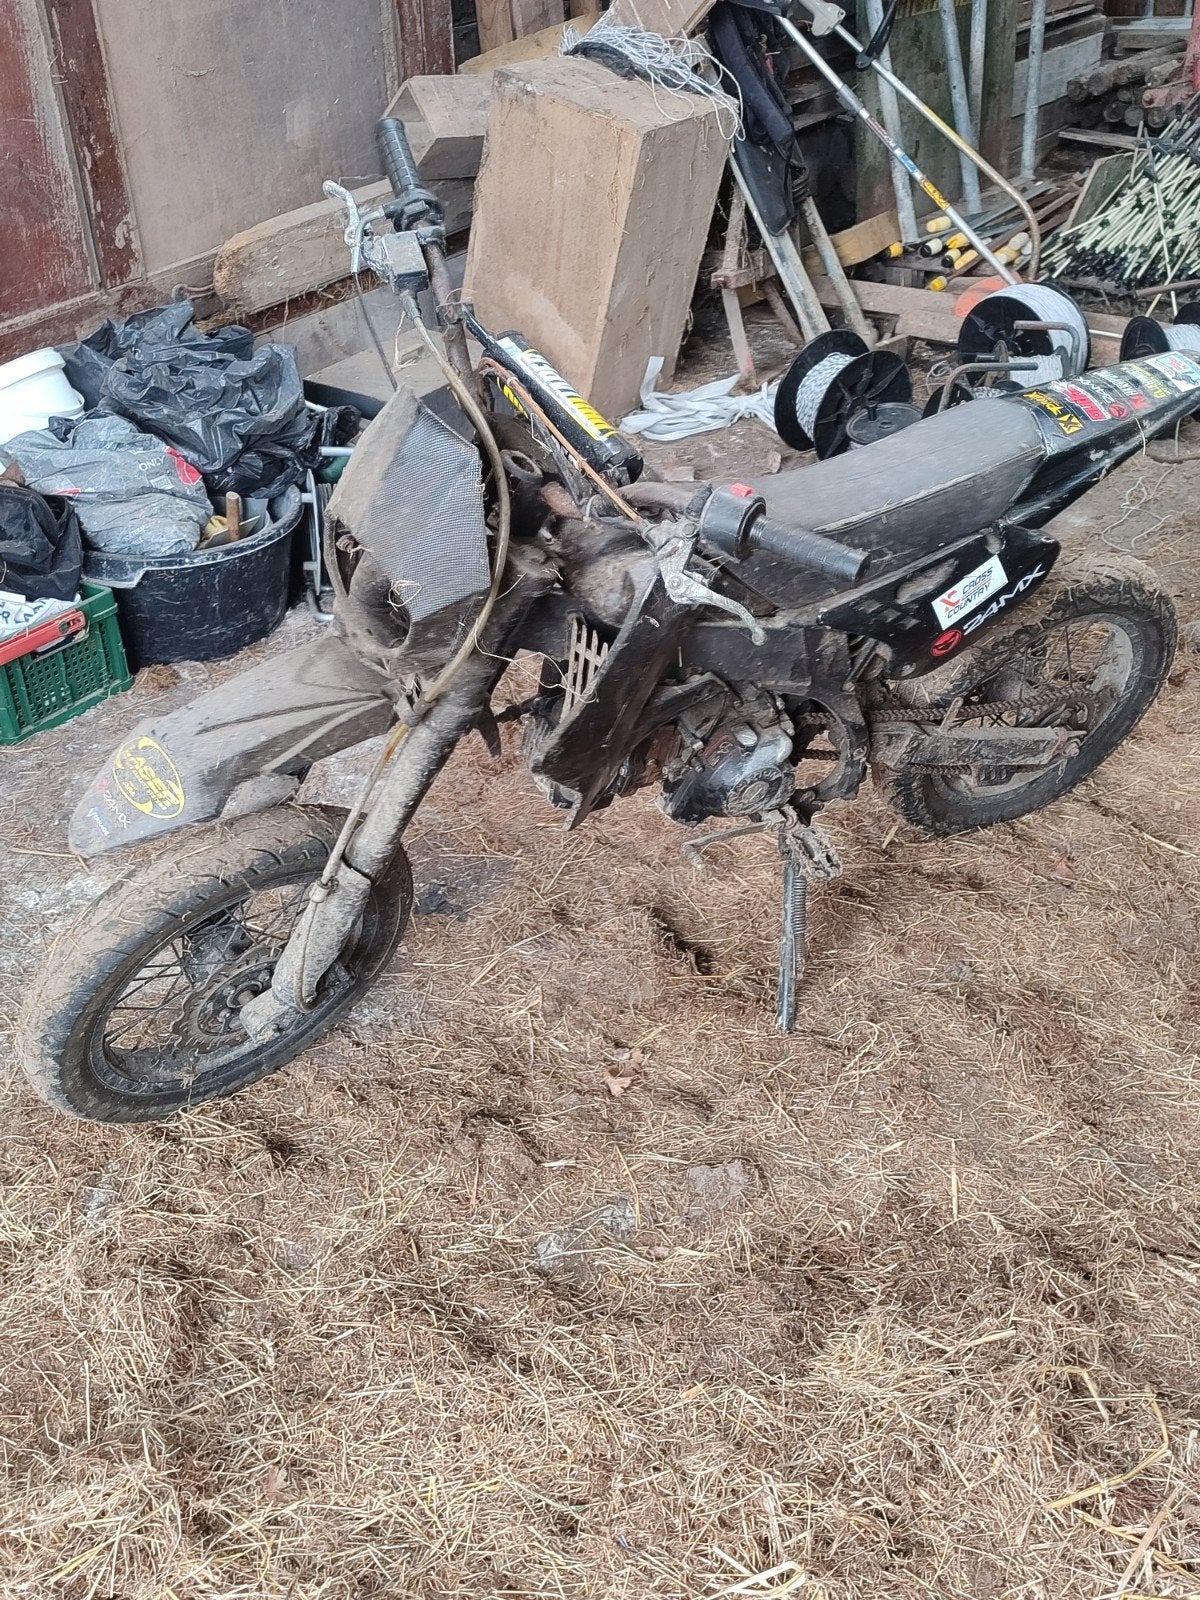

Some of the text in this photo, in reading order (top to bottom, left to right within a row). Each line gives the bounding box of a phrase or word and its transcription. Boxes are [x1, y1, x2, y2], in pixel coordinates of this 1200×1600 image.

[138, 455, 166, 472] ONLY
[962, 566, 994, 595] CROSS
[947, 582, 991, 619] COUNTRY
[963, 563, 1046, 636] 24MX
[102, 790, 132, 829] 24MX
